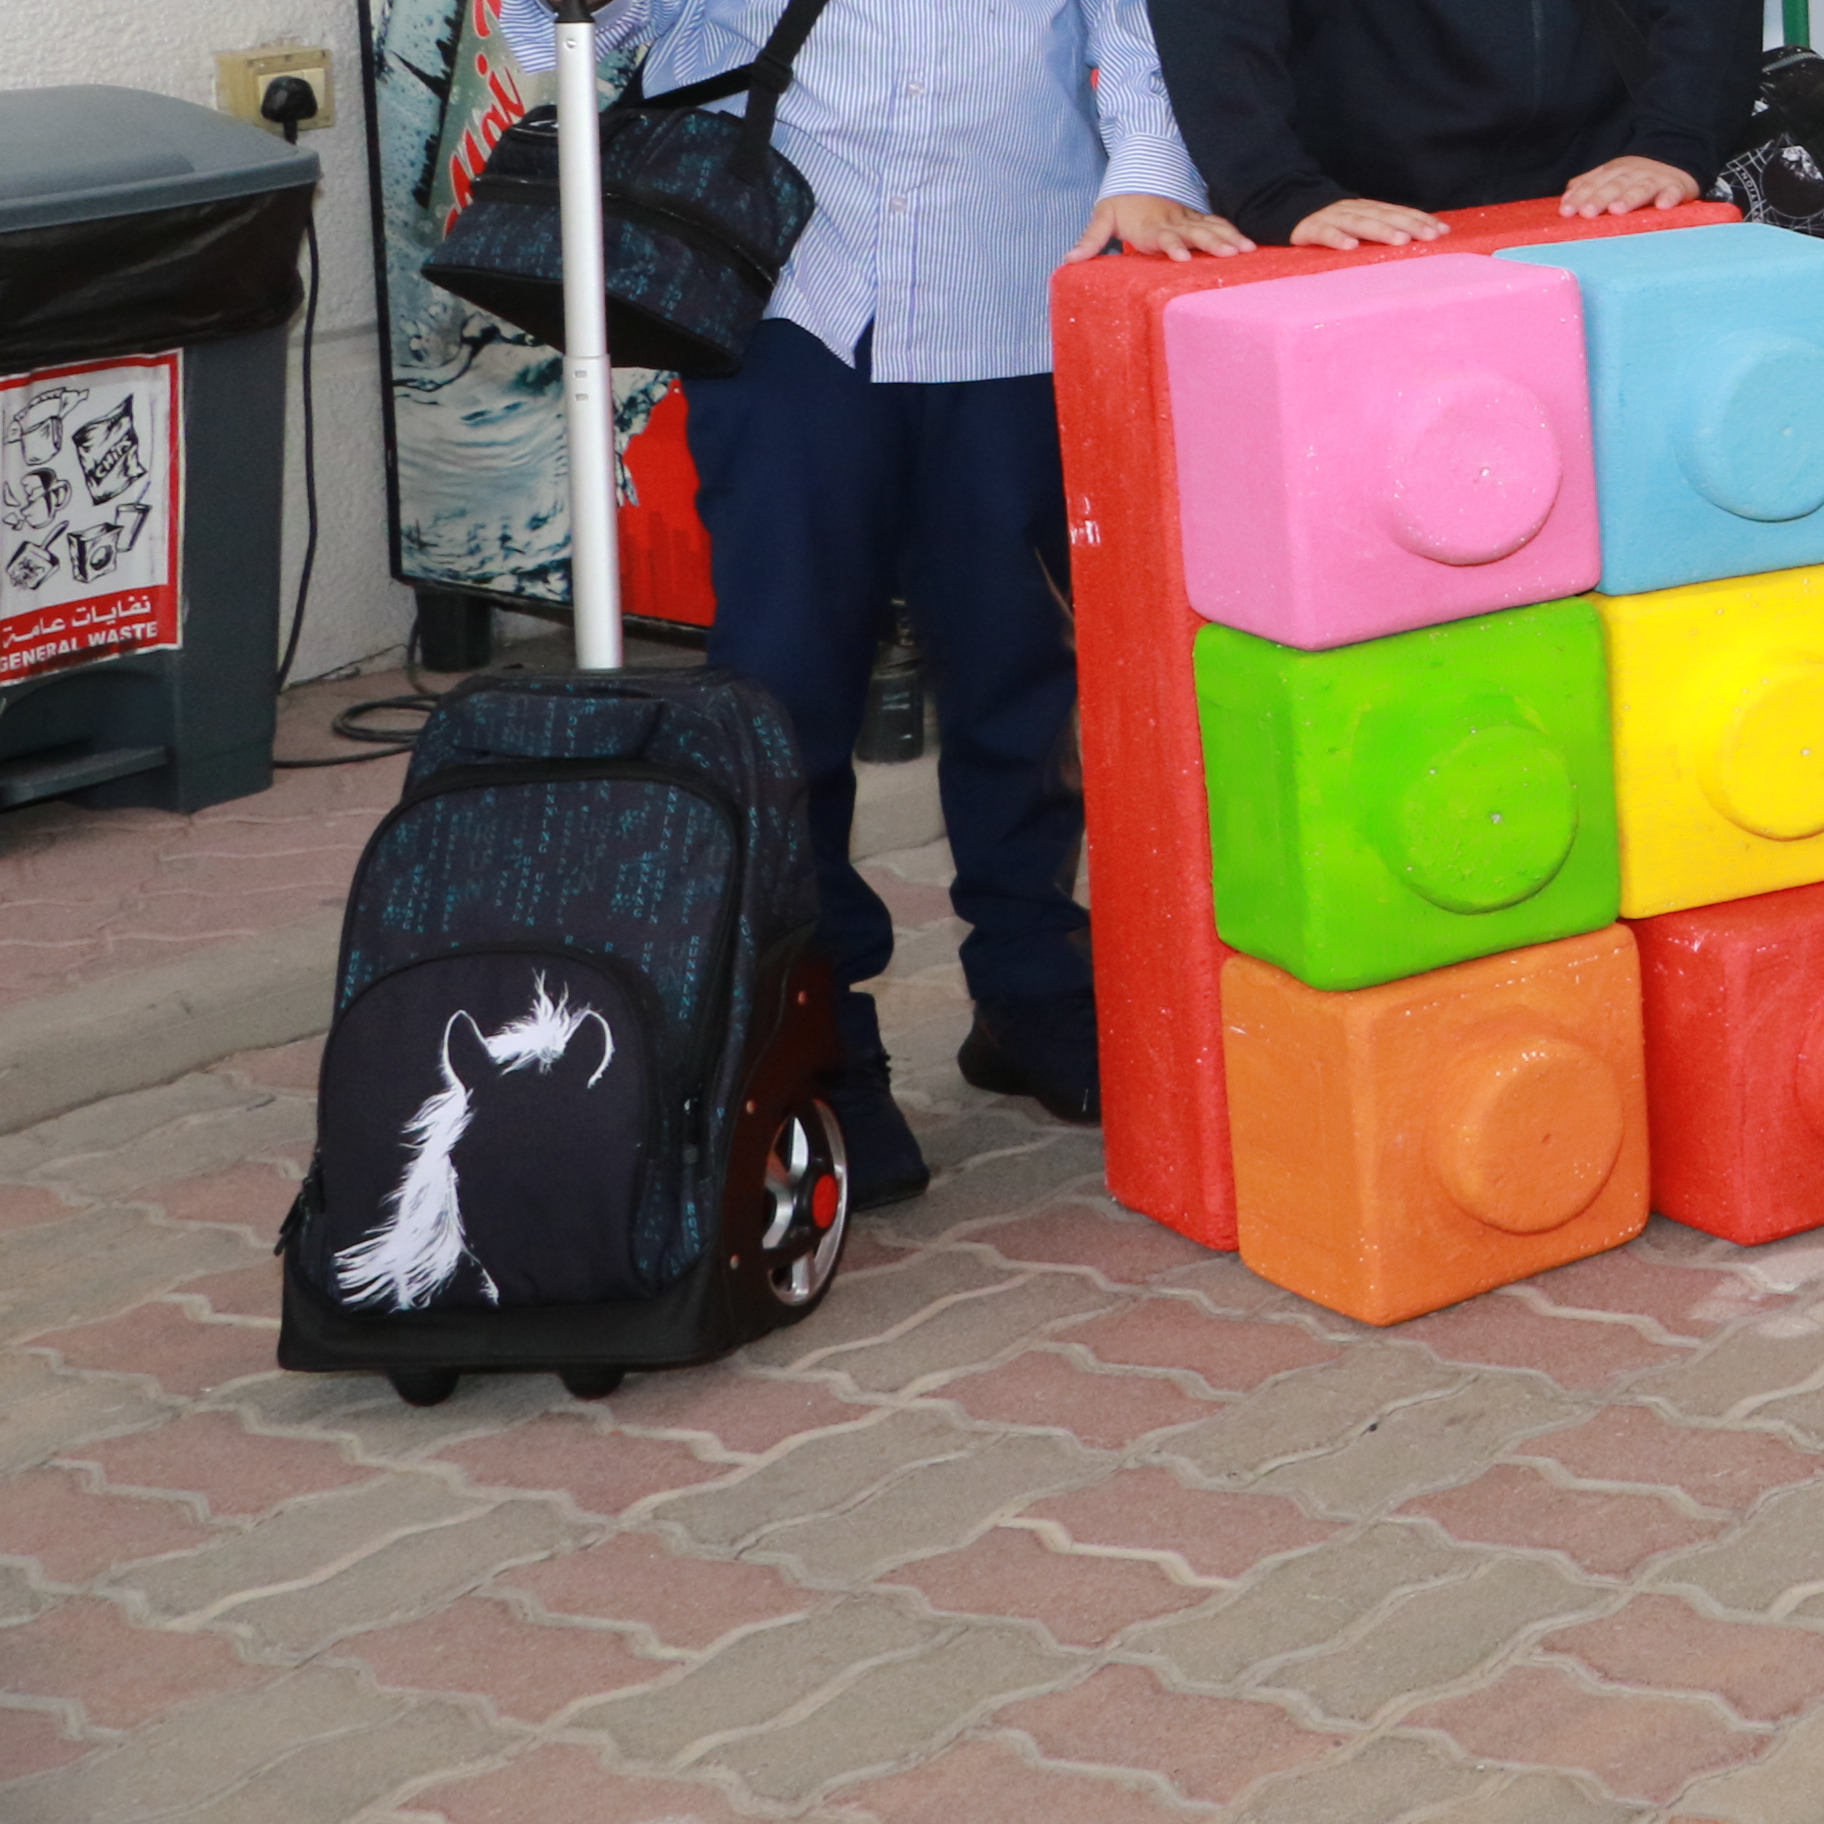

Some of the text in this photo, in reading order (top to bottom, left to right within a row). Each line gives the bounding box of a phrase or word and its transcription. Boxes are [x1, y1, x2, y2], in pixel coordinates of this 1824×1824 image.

[0, 621, 158, 673] GENERAL WASTE
[2, 595, 152, 649] نفايات عامة
